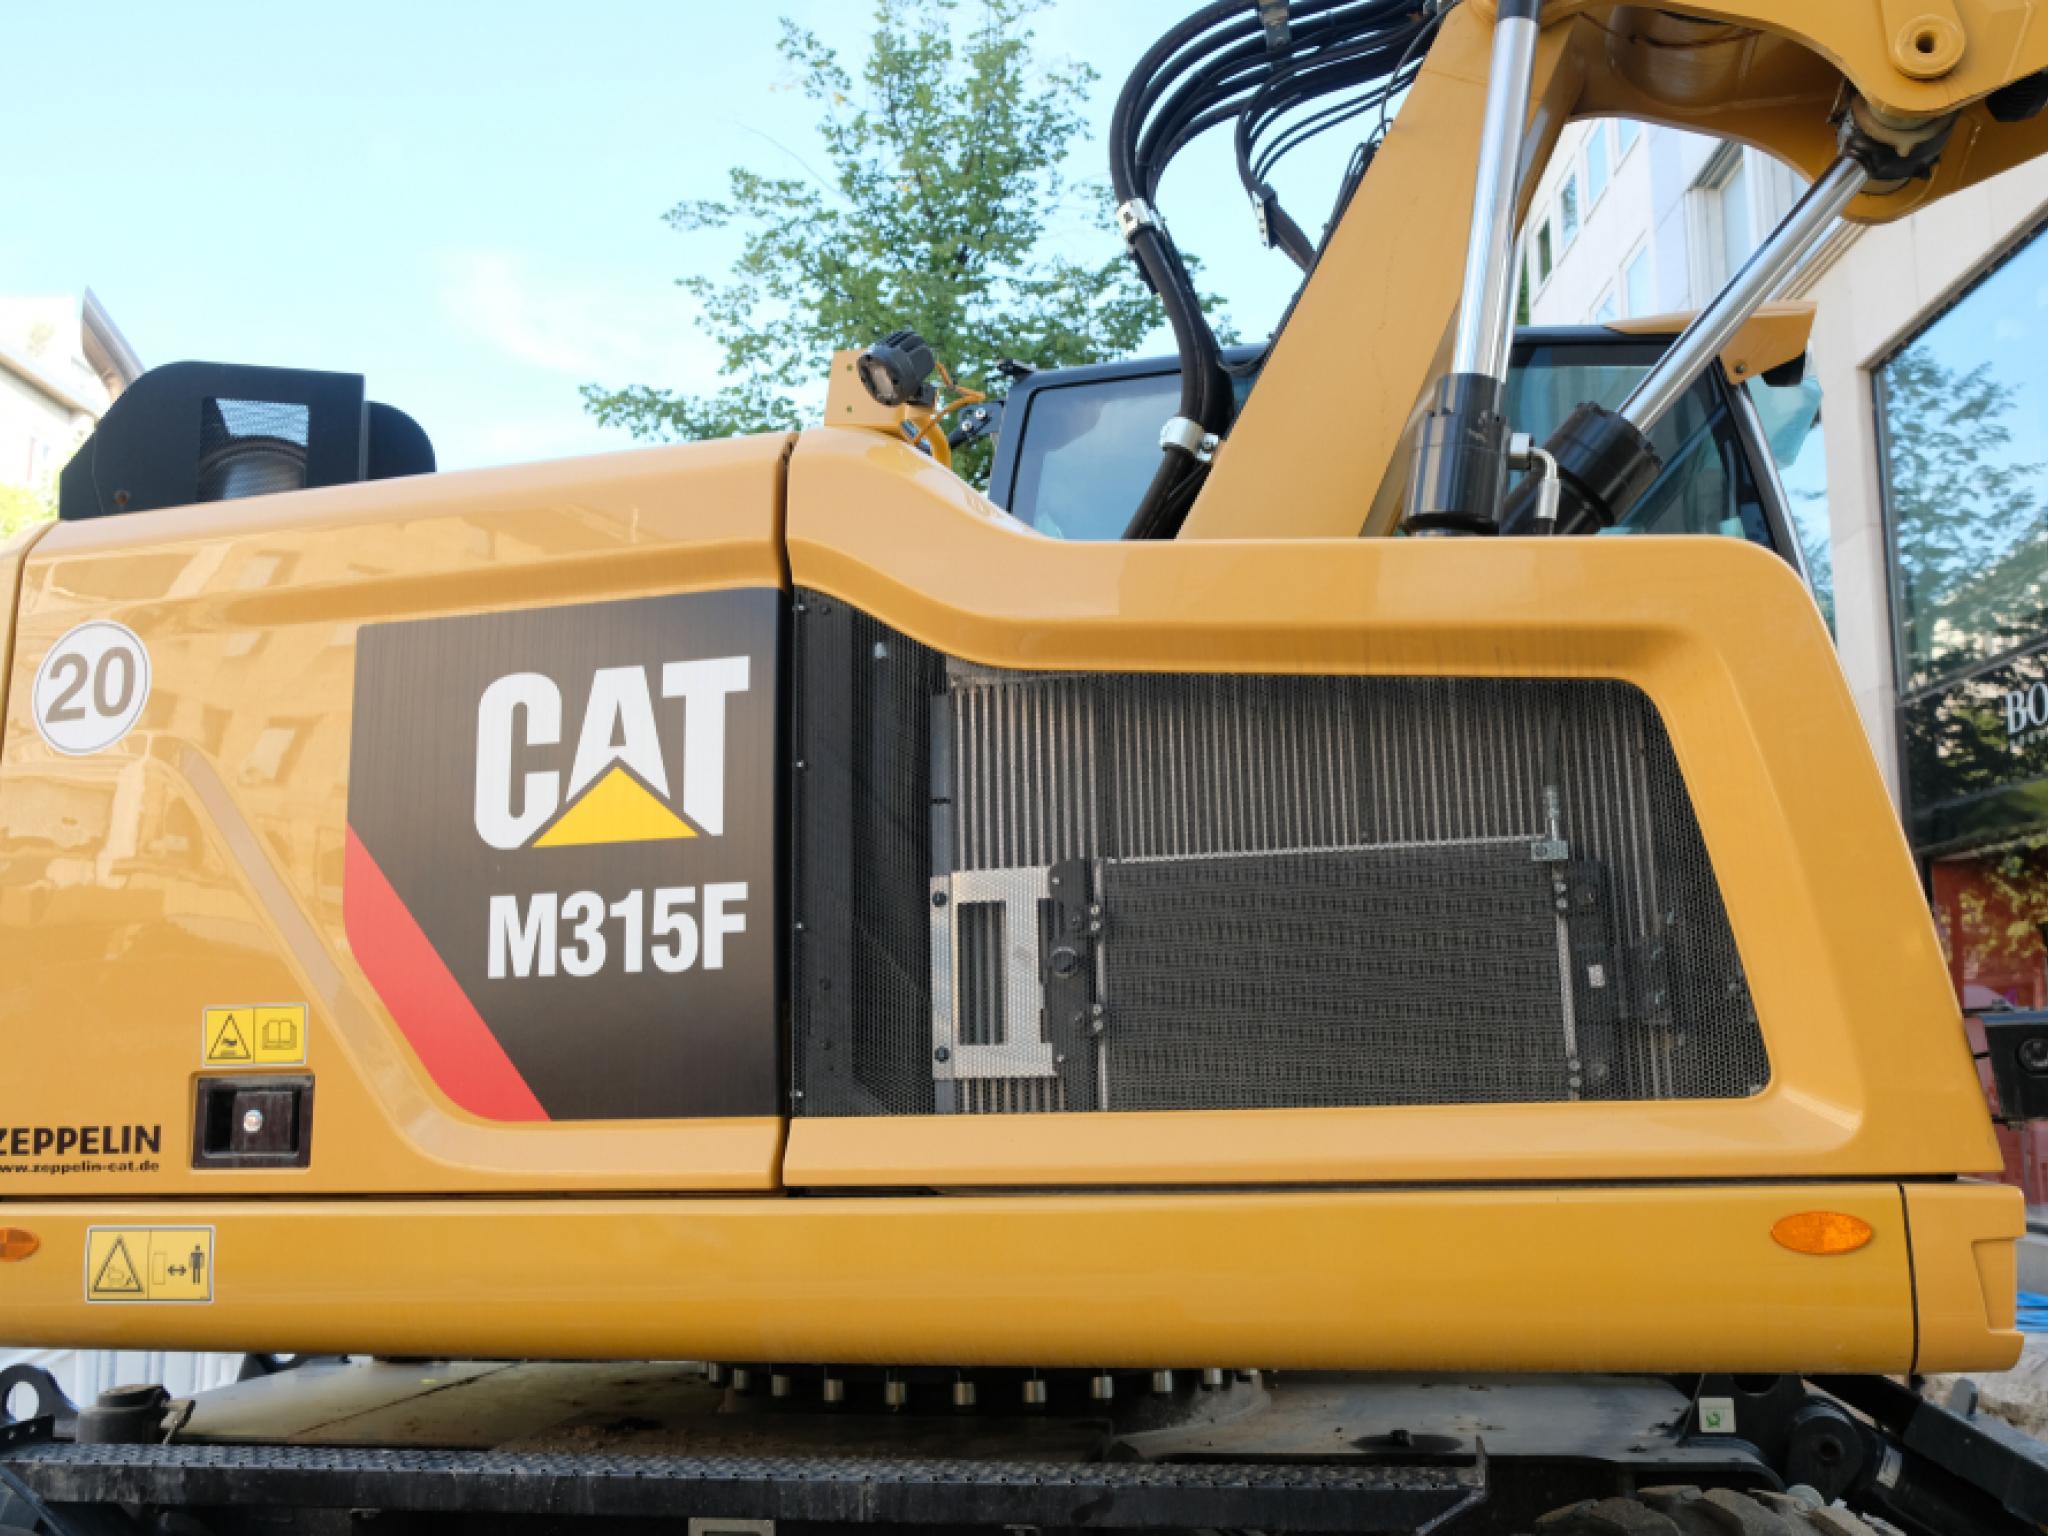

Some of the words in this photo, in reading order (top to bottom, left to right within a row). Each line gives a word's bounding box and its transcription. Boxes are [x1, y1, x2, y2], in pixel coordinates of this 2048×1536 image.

[46, 646, 136, 724] 20
[474, 656, 751, 850] CAT
[487, 881, 749, 980] M315F
